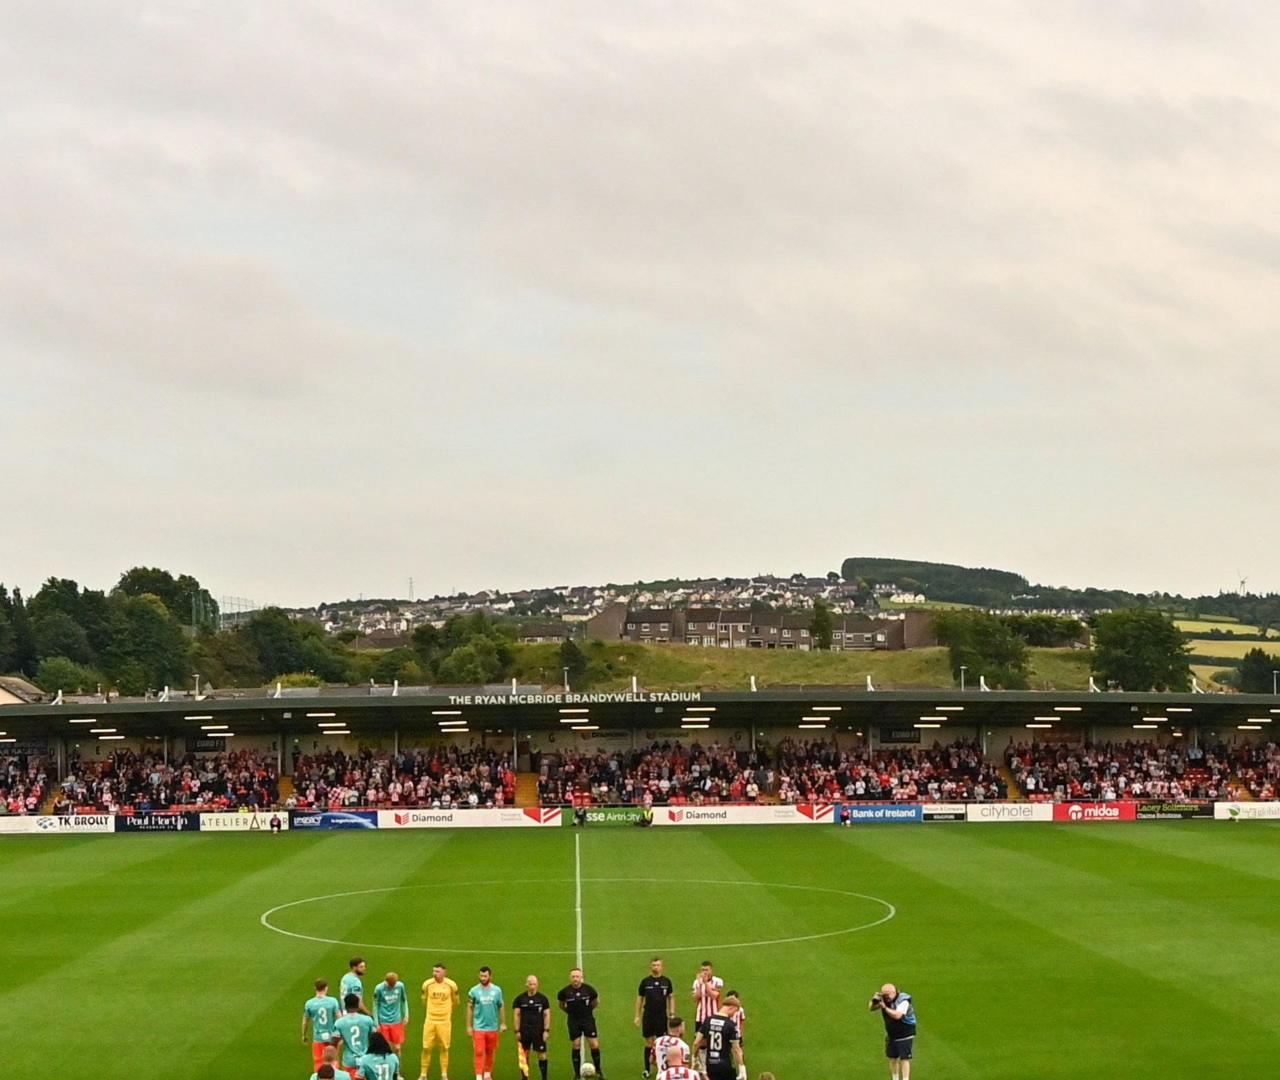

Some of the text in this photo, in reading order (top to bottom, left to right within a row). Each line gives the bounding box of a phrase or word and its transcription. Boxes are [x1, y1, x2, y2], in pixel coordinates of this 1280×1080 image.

[448, 692, 701, 705] THE RYAN MCBRIDE BRANDYWELL STADIUM
[686, 810, 727, 819] Diamond
[852, 809, 915, 818] Bank of Ireland
[981, 804, 1033, 819] cityhotel
[1084, 805, 1119, 817] midas
[57, 816, 109, 826] TK BROLLY
[126, 815, 188, 827] Paul Martin
[200, 815, 250, 827] ATELIER
[411, 813, 453, 823] Diamond
[586, 812, 641, 823] sse Airtricity
[318, 1006, 328, 1025] 3
[350, 1025, 361, 1046] 2
[708, 1030, 723, 1051] 13
